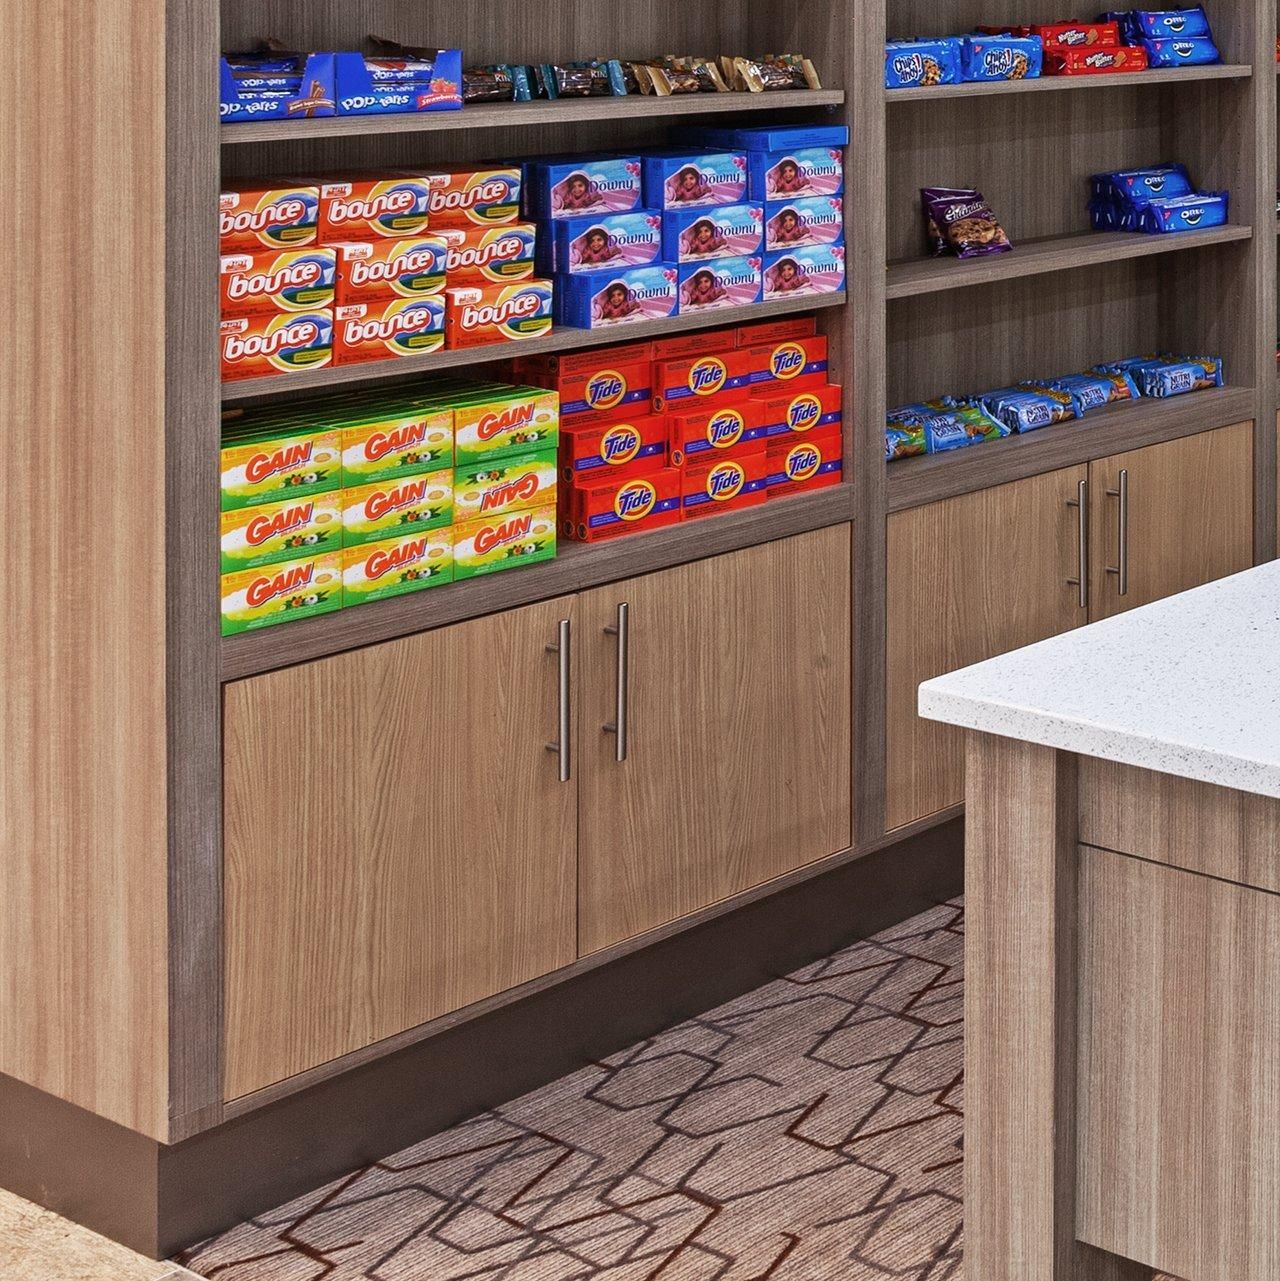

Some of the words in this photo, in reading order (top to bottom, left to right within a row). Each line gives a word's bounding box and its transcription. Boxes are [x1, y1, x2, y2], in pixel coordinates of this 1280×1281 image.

[588, 178, 634, 193] Downy
[699, 172, 741, 186] Downy
[797, 165, 838, 179] Downy
[330, 190, 413, 224] bounce
[430, 182, 506, 212] bounce
[220, 201, 303, 235] bounce
[714, 223, 757, 237] Downy
[796, 213, 837, 226] Downy
[447, 238, 522, 268] bounce
[607, 232, 654, 247] Downy
[352, 249, 433, 284] bounce
[713, 273, 756, 287] Downy
[796, 261, 838, 276] Downy
[229, 263, 319, 298] bounce
[626, 285, 671, 302] Downy
[461, 295, 539, 329] bounce
[344, 309, 430, 344] bounce
[224, 323, 316, 361] bounce
[691, 365, 724, 387] Tide
[772, 351, 804, 374] Tide
[588, 380, 624, 402] Tide
[477, 402, 536, 440] GAIN
[790, 403, 819, 426] Tide
[364, 421, 428, 462] GAIN
[710, 419, 741, 442] Tide
[604, 433, 638, 457] Tide
[246, 441, 314, 484] GAIN
[788, 451, 818, 475] Tide
[480, 472, 540, 512] GAIN
[709, 470, 741, 495] Tide
[364, 479, 428, 522] GAIN
[619, 488, 653, 513] Tide
[246, 501, 314, 546] GAIN
[473, 513, 532, 556] GAIN
[364, 537, 428, 580] GAIN
[246, 562, 315, 608] GAIN
